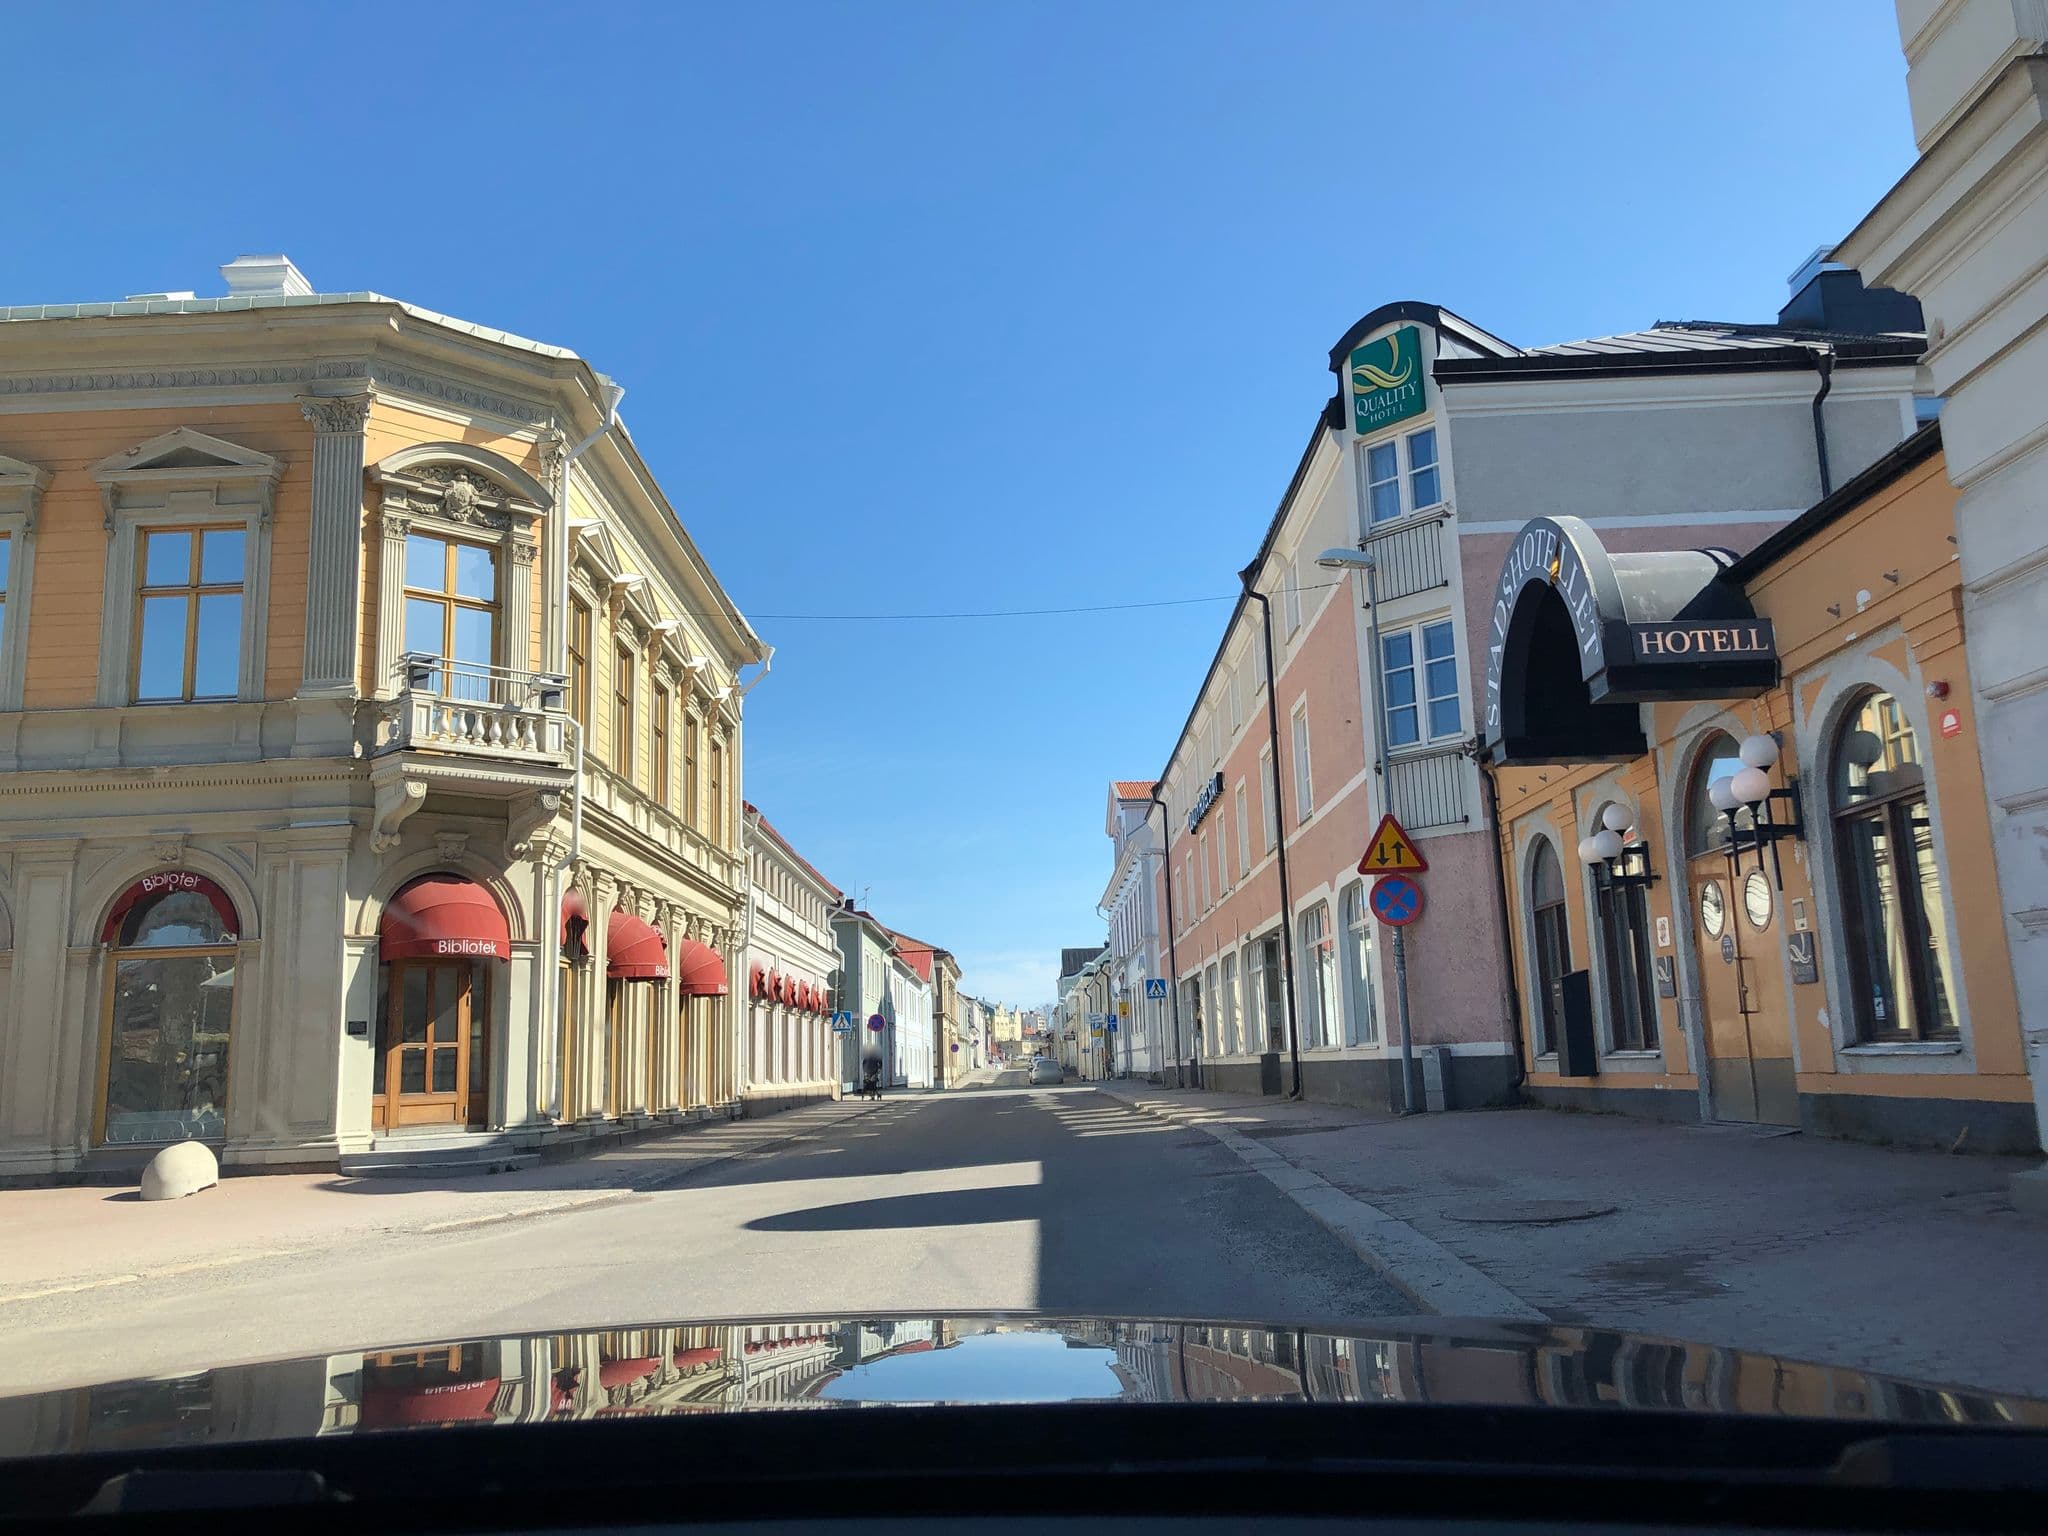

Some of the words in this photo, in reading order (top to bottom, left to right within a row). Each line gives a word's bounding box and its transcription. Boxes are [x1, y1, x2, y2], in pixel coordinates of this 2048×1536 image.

[1356, 381, 1417, 416] QUALITY
[1487, 528, 1600, 727] STADSHOTELLET
[1639, 628, 1769, 654] HOTELL
[438, 939, 497, 954] Bibliotek
